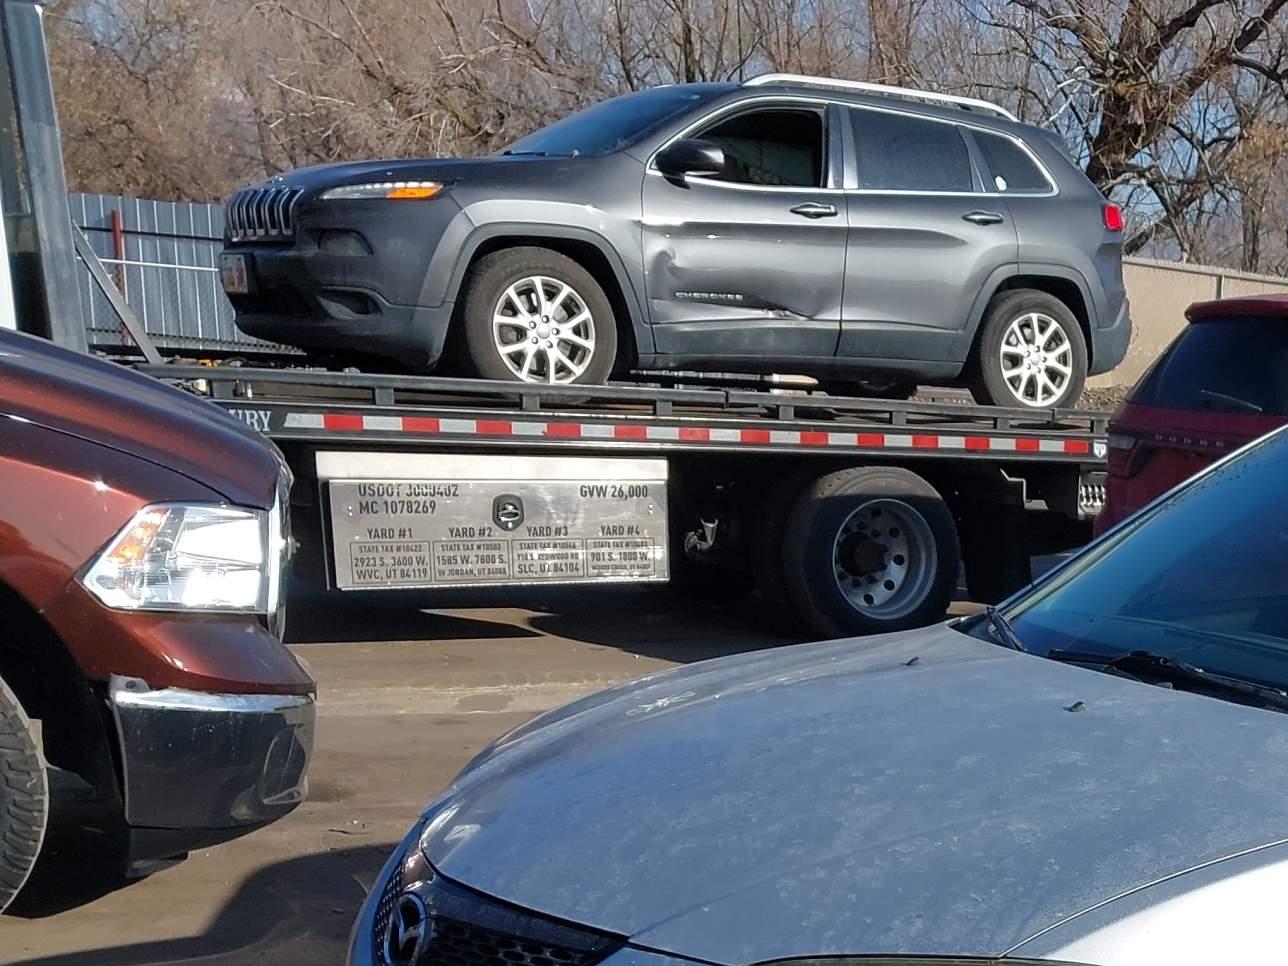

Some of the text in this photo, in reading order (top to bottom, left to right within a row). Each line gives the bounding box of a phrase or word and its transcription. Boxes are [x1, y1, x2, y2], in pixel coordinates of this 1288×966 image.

[580, 485, 648, 501] GVW 26,000
[359, 500, 436, 514] MC 1078269
[367, 528, 413, 539] YARD #1
[448, 527, 493, 538] YARD #2
[526, 526, 569, 537] YARD #3
[600, 525, 640, 536] YARD #4
[358, 545, 379, 553] STATE
[381, 545, 394, 553] TAX
[440, 544, 461, 552] STATE
[462, 543, 475, 552] TAX
[519, 542, 538, 550] STATE
[353, 556, 429, 568] 2923 S. 3600 W.
[437, 553, 507, 566] 1585 W. 7800 S.
[552, 562, 579, 573] 84104
[356, 568, 427, 580] WVC, UT 84119
